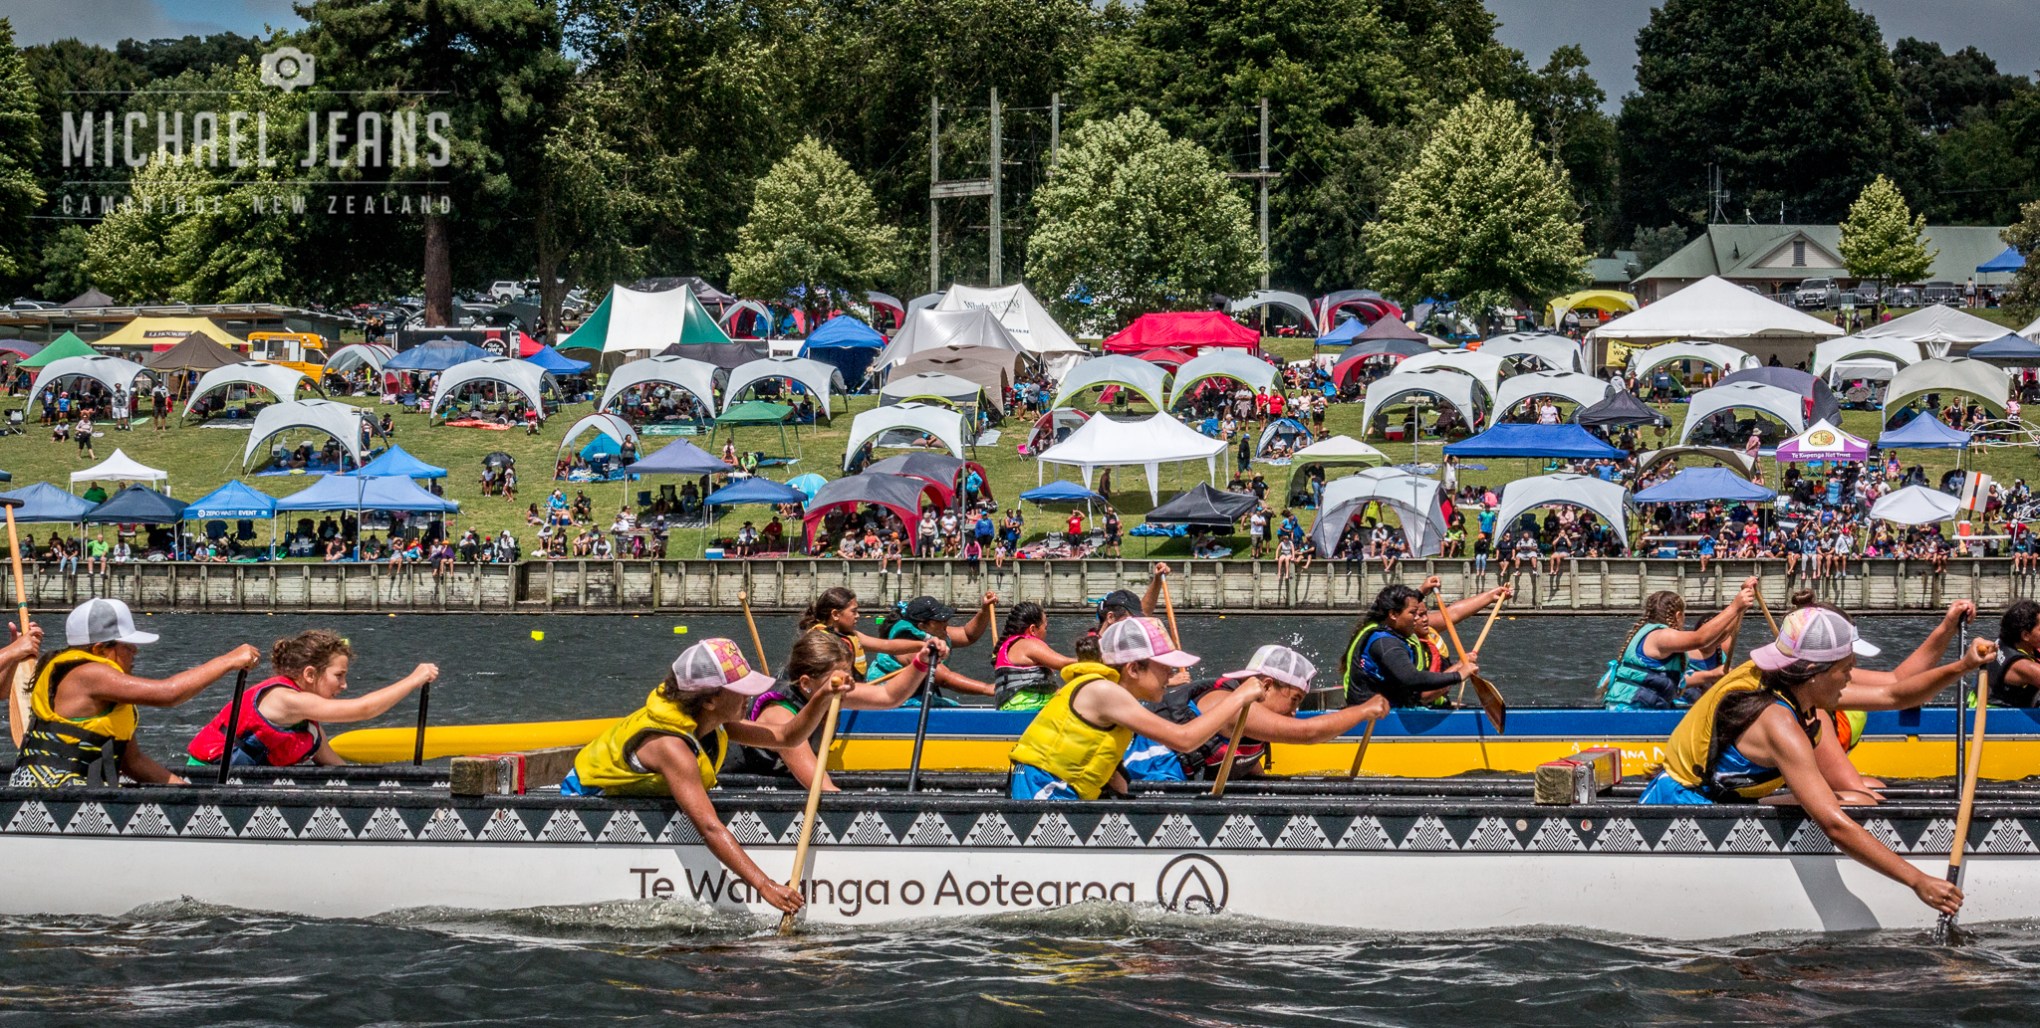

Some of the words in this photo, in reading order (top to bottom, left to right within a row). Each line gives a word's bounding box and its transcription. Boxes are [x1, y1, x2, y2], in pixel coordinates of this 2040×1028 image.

[629, 867, 675, 900] Te
[900, 879, 926, 906] o
[933, 869, 1135, 907] Aotearoa
